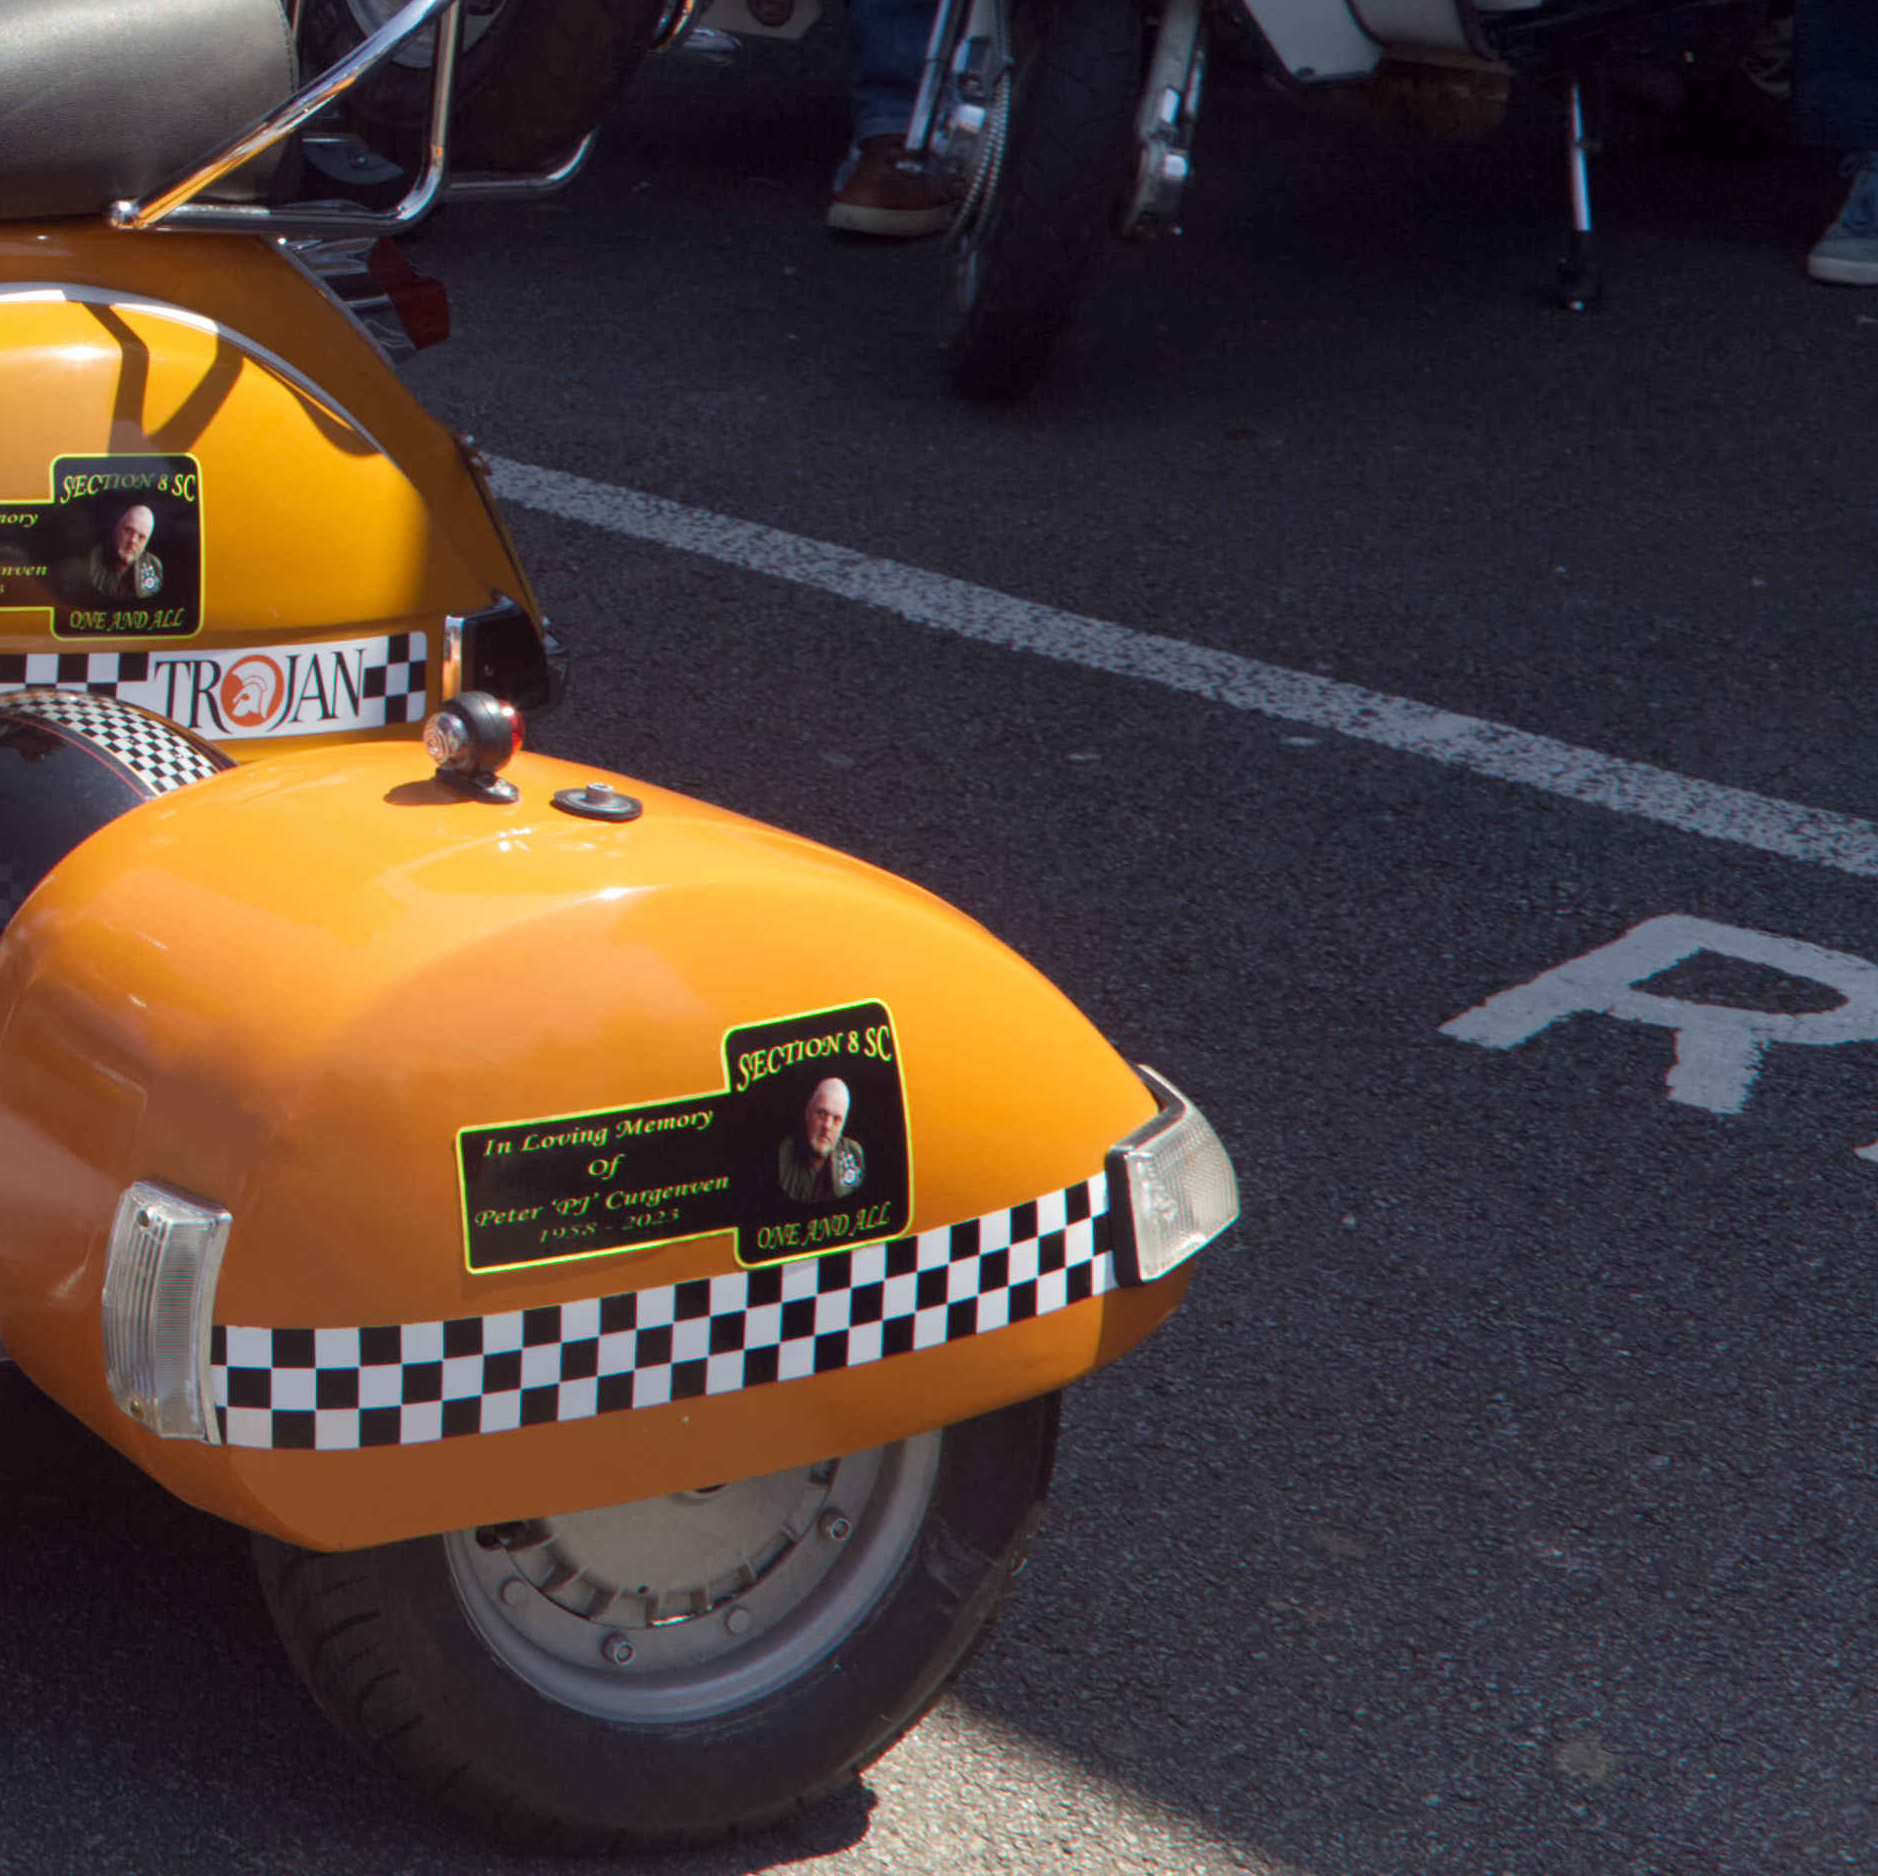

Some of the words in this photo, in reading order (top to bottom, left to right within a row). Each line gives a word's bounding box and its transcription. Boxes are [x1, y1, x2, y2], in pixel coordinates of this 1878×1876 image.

[60, 472, 154, 505] SECTION
[157, 475, 169, 492] 8
[171, 474, 197, 502] SC
[69, 610, 108, 631] ONE
[107, 610, 149, 632] AND
[148, 607, 185, 632] ALL
[735, 1031, 844, 1092] SECTION
[846, 1029, 860, 1053] 8
[863, 1025, 894, 1062] SC
[1438, 912, 1878, 1164] R
[483, 1139, 513, 1157] In
[520, 1126, 610, 1152] Loving
[615, 1110, 714, 1139] Memory
[587, 1153, 626, 1180] Of
[474, 1206, 544, 1226] Peter
[604, 1176, 730, 1210] Curgenven
[539, 1222, 598, 1243] 1958
[621, 1208, 681, 1230] 2023
[756, 1221, 802, 1250] ONE
[799, 1211, 850, 1247] AND
[848, 1201, 892, 1238] ALL
